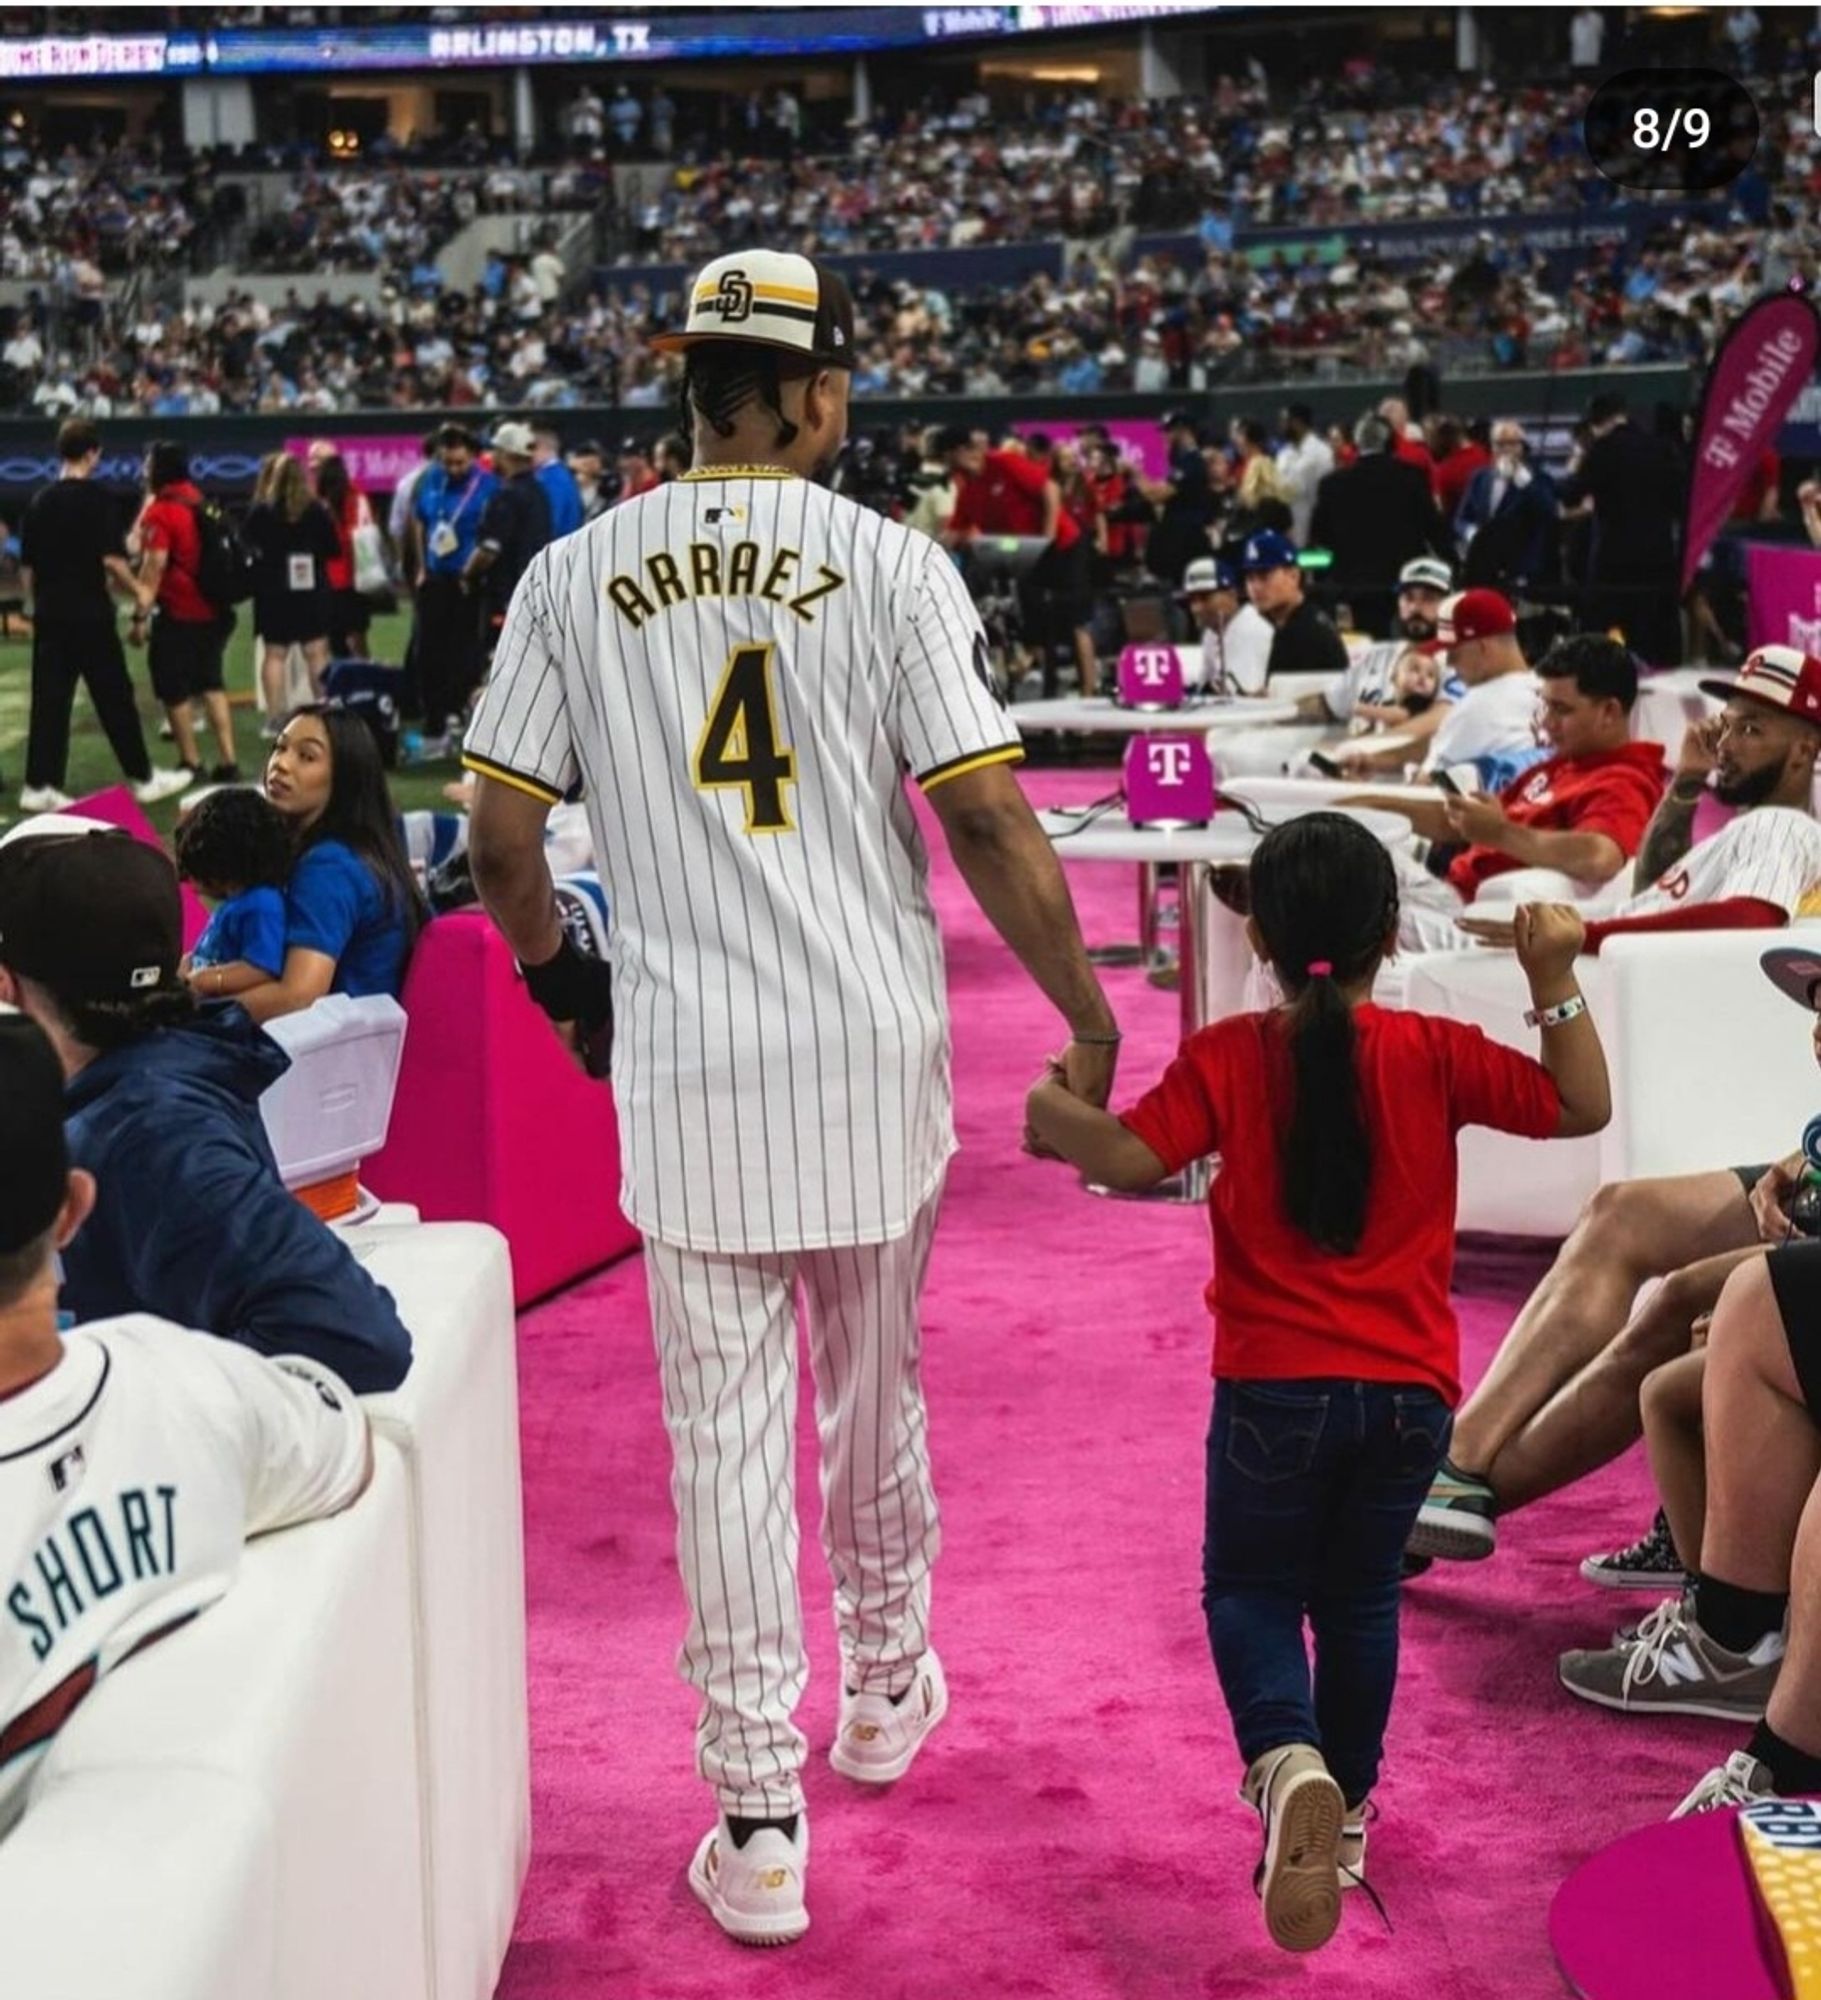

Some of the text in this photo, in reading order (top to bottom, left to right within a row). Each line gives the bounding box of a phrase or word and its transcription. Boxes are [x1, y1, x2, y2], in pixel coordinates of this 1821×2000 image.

[612, 24, 650, 52] TX
[1723, 328, 1802, 440] Mobile
[606, 540, 846, 630] ARRAEZ
[1134, 650, 1170, 685] T
[693, 640, 798, 833] 4
[1148, 742, 1191, 785] T
[7, 1484, 177, 1662] SHORT
